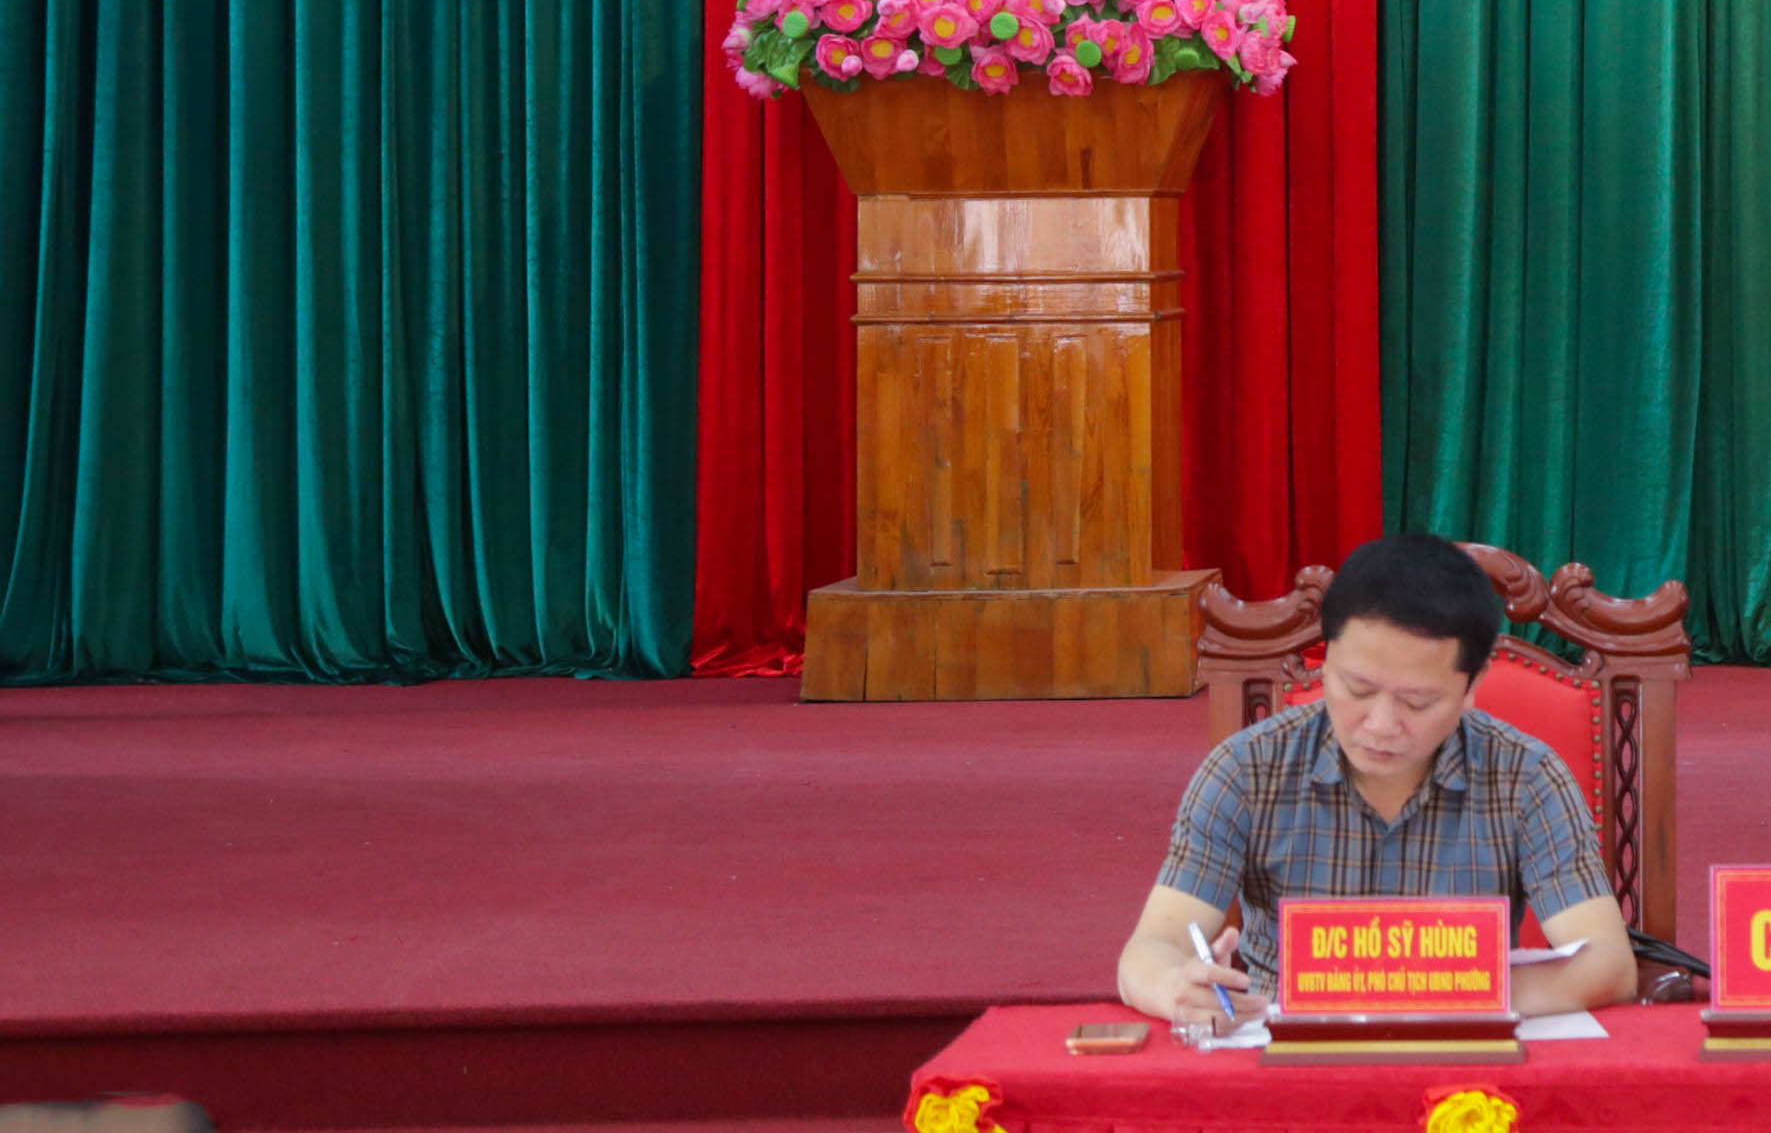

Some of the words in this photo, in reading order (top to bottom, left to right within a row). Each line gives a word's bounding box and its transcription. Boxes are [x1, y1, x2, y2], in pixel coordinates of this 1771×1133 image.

[1311, 925, 1349, 959] Đ/C
[1387, 919, 1415, 959] SỸ
[1419, 919, 1478, 959] HÙNG
